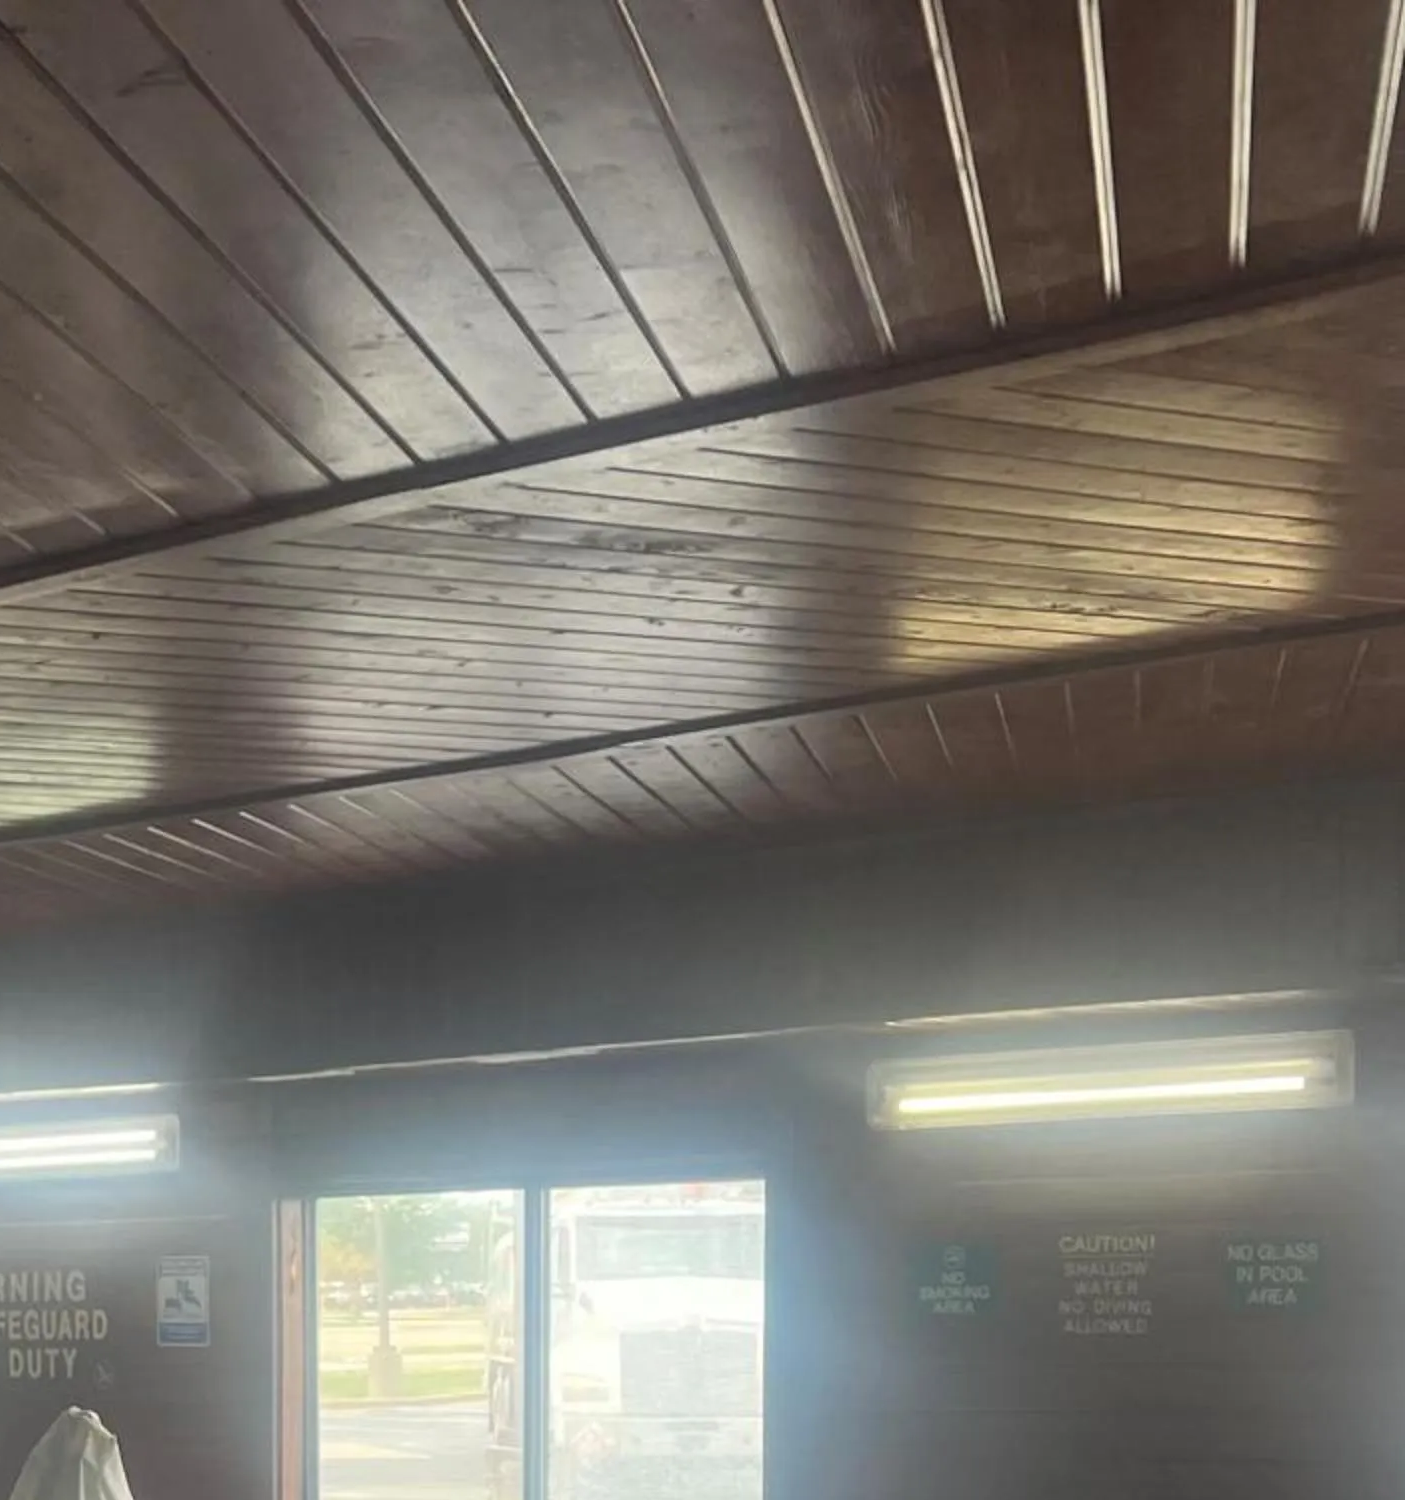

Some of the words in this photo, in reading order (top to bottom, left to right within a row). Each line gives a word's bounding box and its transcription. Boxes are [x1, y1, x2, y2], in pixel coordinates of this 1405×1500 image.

[1058, 1234, 1155, 1253] CAUTION!
[1227, 1244, 1255, 1261] NO
[1256, 1242, 1319, 1260] GLASS
[941, 1271, 966, 1284] NO
[1236, 1265, 1254, 1283] IN
[1259, 1265, 1308, 1282] POOL
[1246, 1287, 1298, 1304] AREA
[933, 1300, 975, 1314] AREA
[9, 1347, 77, 1379] DUTY
